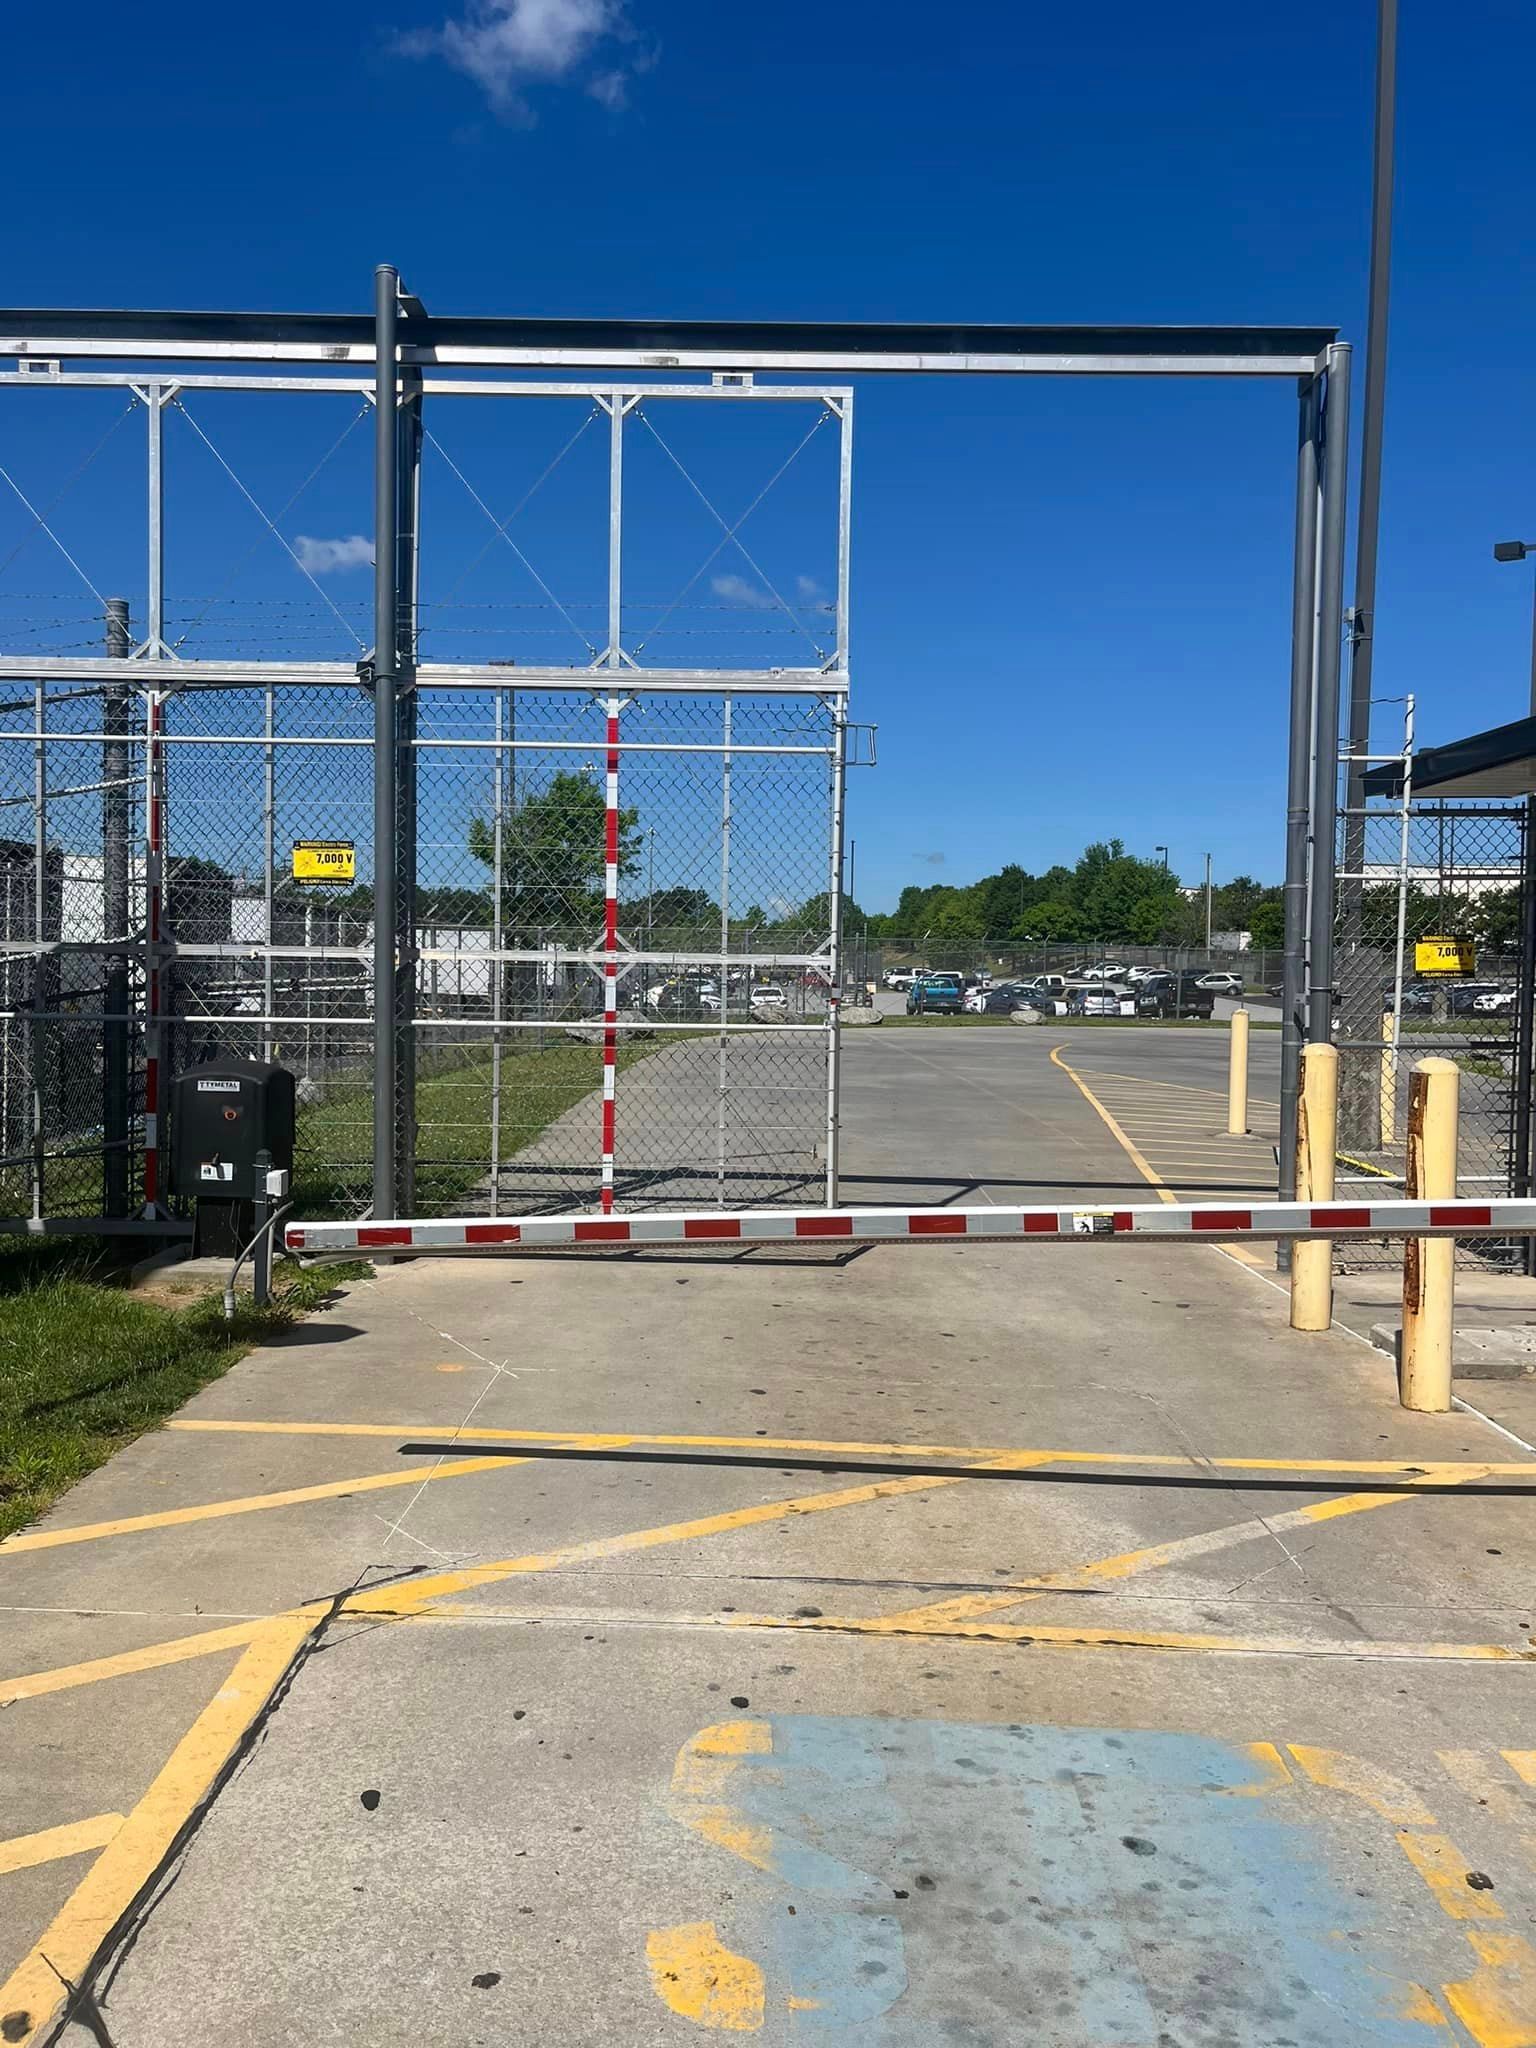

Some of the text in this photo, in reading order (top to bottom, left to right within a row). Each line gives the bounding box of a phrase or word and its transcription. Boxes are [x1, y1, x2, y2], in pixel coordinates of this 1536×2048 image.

[316, 853, 353, 864] 7,000 V
[1437, 947, 1473, 958] 7,000 V
